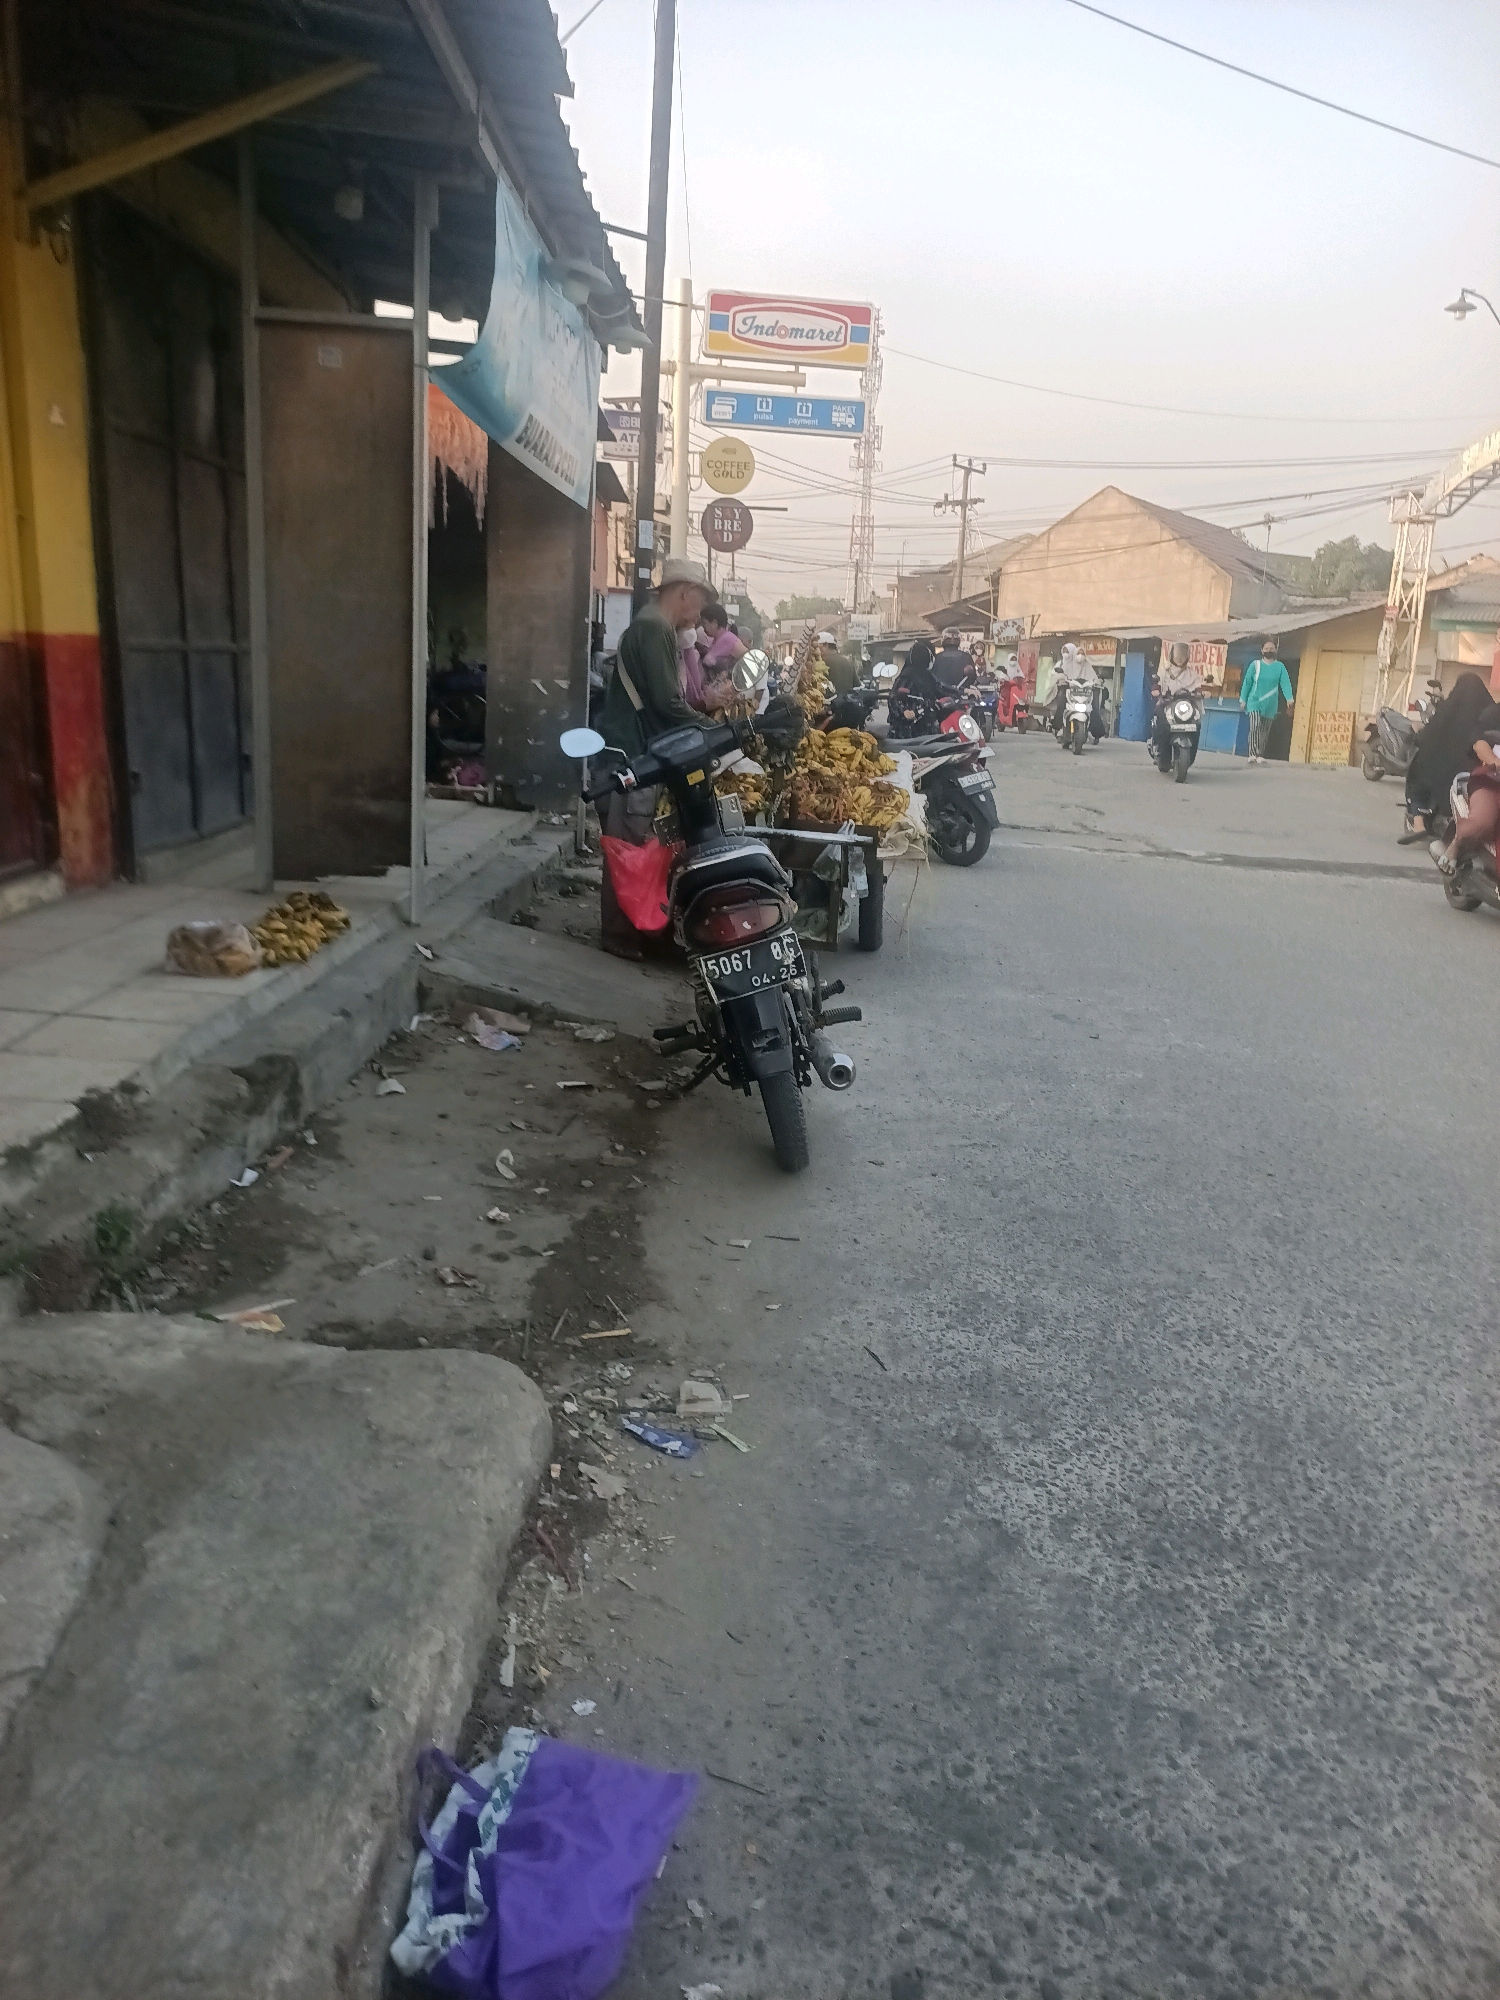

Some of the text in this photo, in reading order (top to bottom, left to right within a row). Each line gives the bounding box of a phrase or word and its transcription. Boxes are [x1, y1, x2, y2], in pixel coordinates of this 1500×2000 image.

[736, 315, 844, 342] Indomaret
[832, 405, 857, 414] PAKET
[753, 412, 774, 421] pulsa
[788, 417, 819, 426] payment
[706, 460, 750, 470] COFFEE
[713, 469, 745, 479] GOLD
[1319, 712, 1352, 722] NASI
[1316, 723, 1350, 732] BEBEK
[1315, 734, 1349, 743] AYAM
[706, 948, 752, 979] 5067
